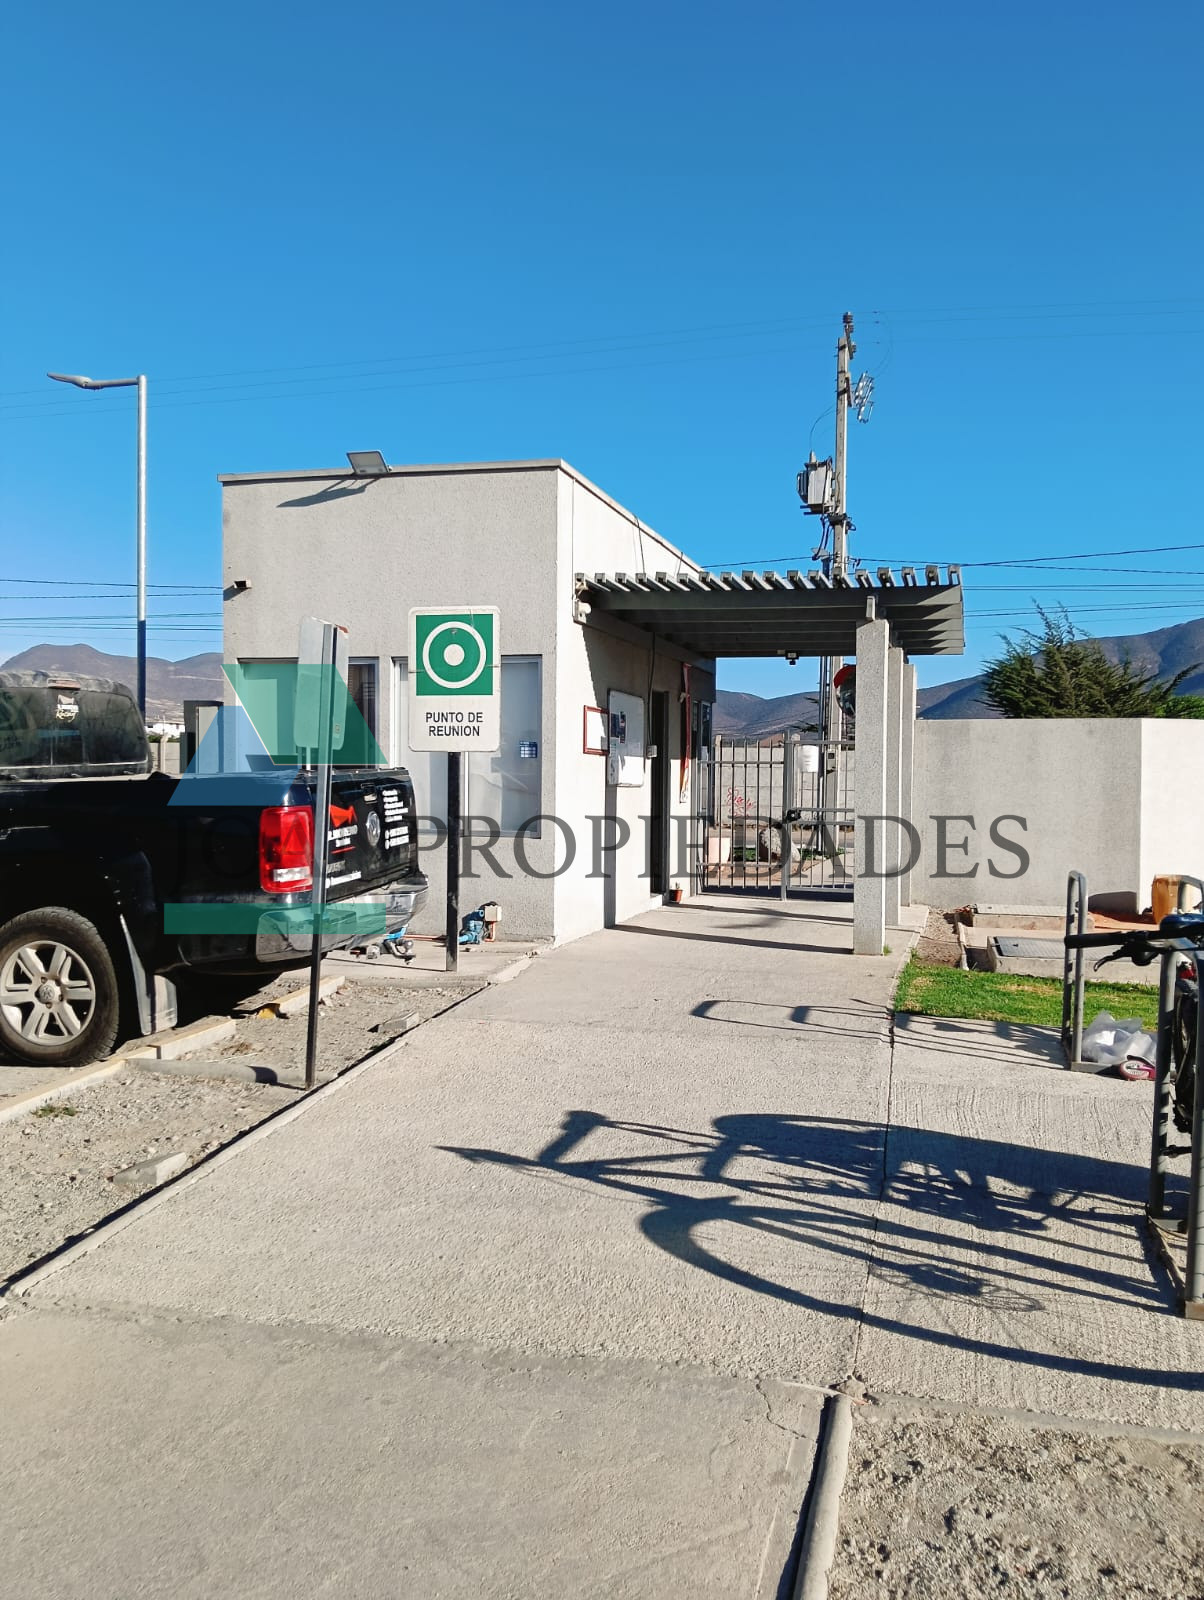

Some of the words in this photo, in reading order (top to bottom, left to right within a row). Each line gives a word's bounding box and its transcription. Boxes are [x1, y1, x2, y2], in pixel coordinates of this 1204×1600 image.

[425, 712, 464, 723] PUNTO
[468, 712, 483, 723] DE
[428, 725, 480, 737] REUNION
